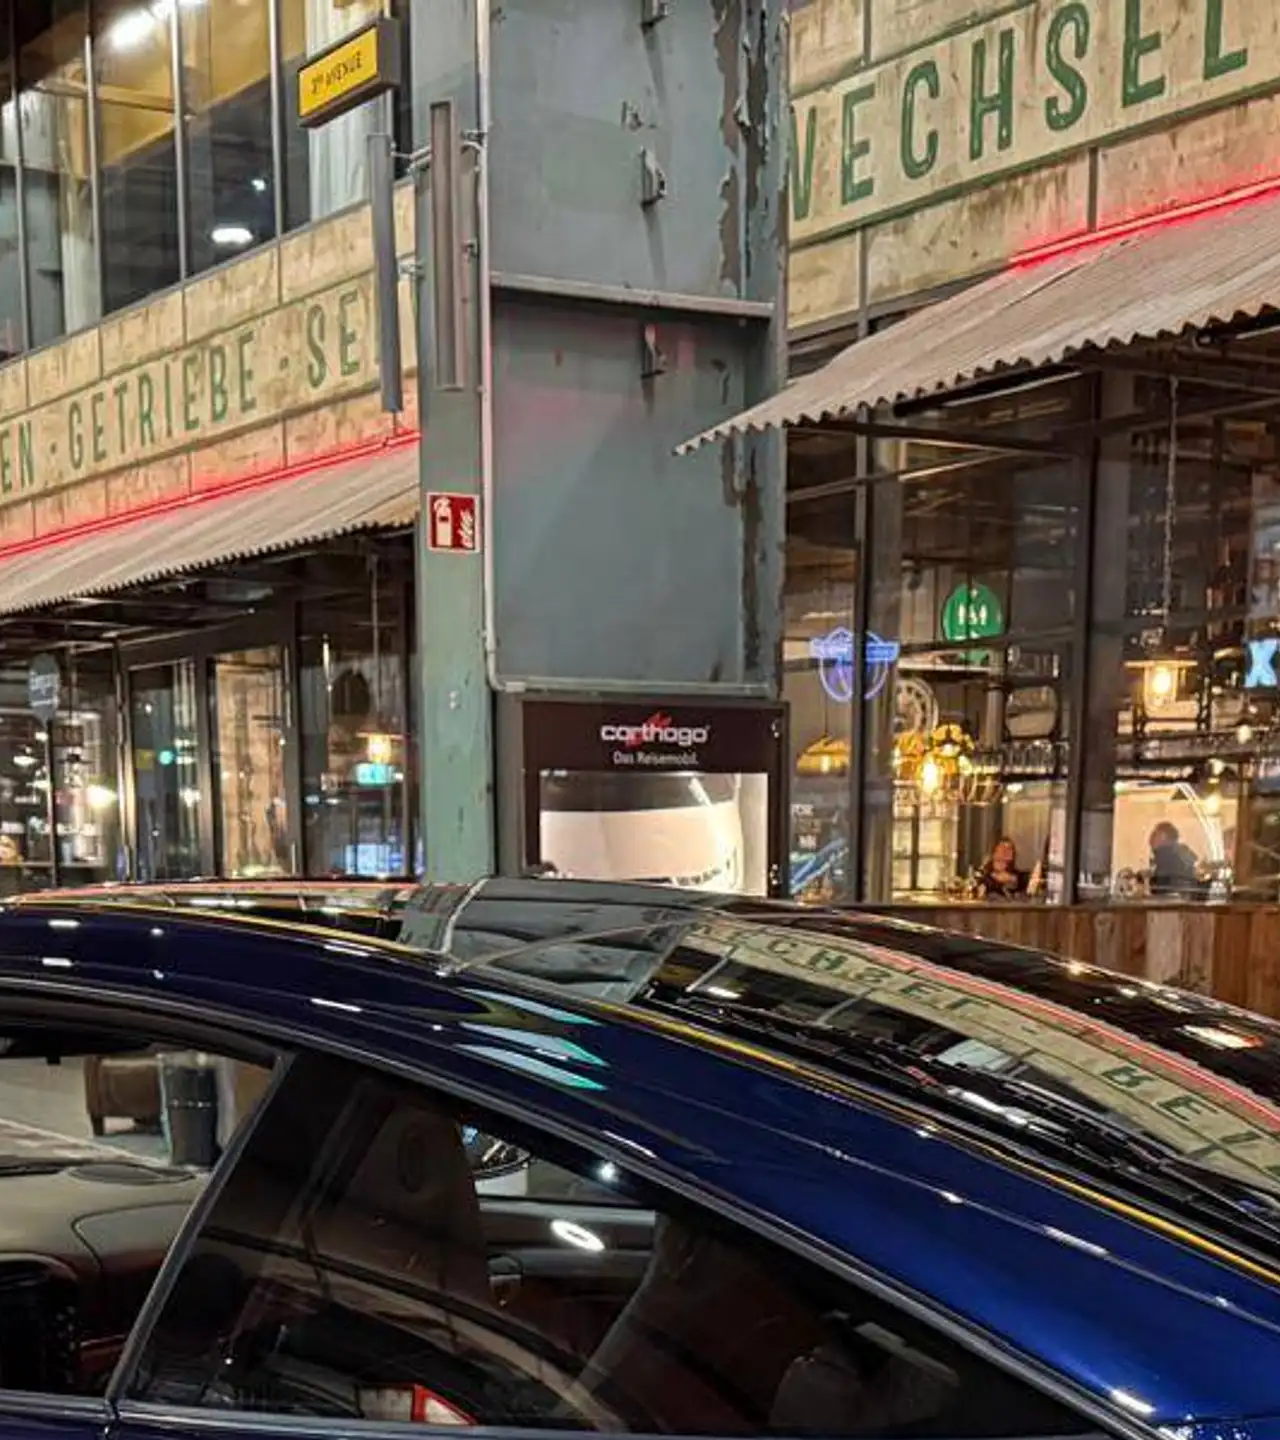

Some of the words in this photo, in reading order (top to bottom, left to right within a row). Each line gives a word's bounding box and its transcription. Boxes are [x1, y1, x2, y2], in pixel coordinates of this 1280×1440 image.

[68, 328, 257, 470] GETRIEBE
[304, 287, 365, 391] SE
[600, 722, 708, 746] carthago
